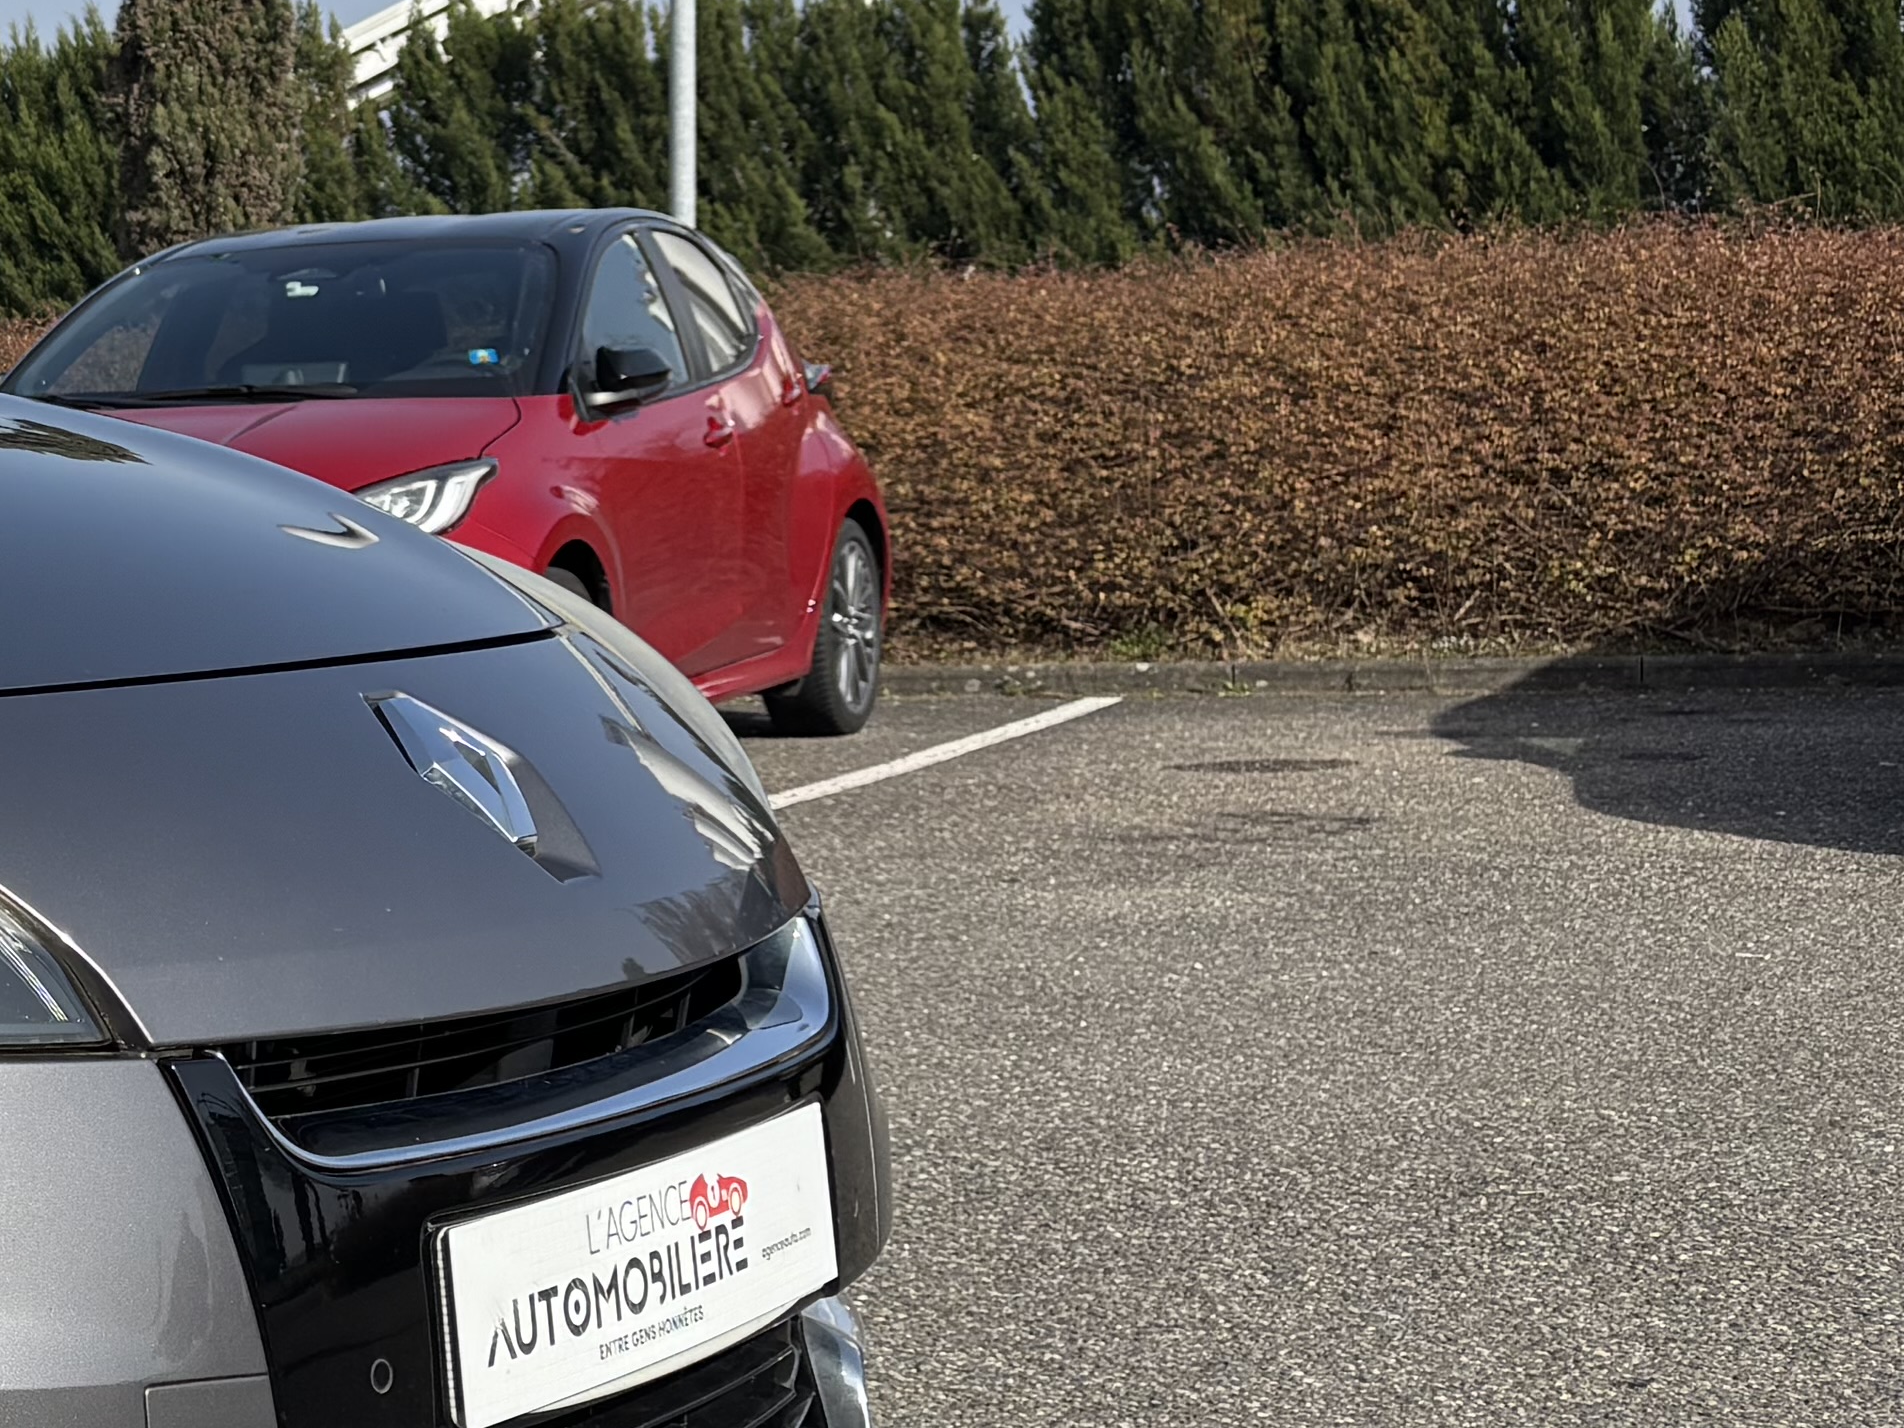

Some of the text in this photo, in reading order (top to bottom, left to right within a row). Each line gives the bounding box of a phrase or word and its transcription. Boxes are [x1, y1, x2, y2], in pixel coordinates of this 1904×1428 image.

[585, 1180, 693, 1255] L'AGENCE
[599, 1334, 630, 1360] ENTRE
[632, 1324, 657, 1347] GENS
